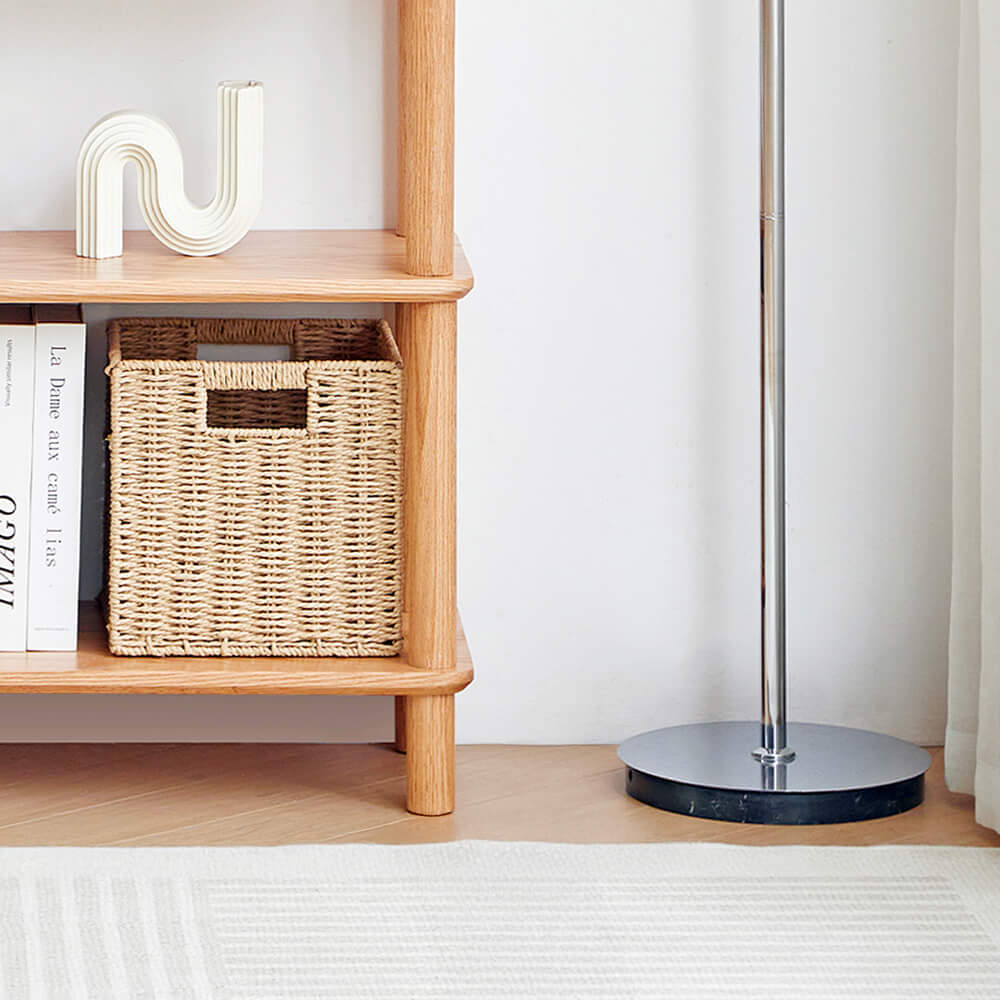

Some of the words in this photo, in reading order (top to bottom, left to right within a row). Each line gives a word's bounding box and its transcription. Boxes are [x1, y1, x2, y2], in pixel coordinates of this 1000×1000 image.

[50, 346, 67, 366] La
[49, 378, 66, 420] Dame
[49, 430, 60, 461] aux
[46, 529, 62, 568] lias
